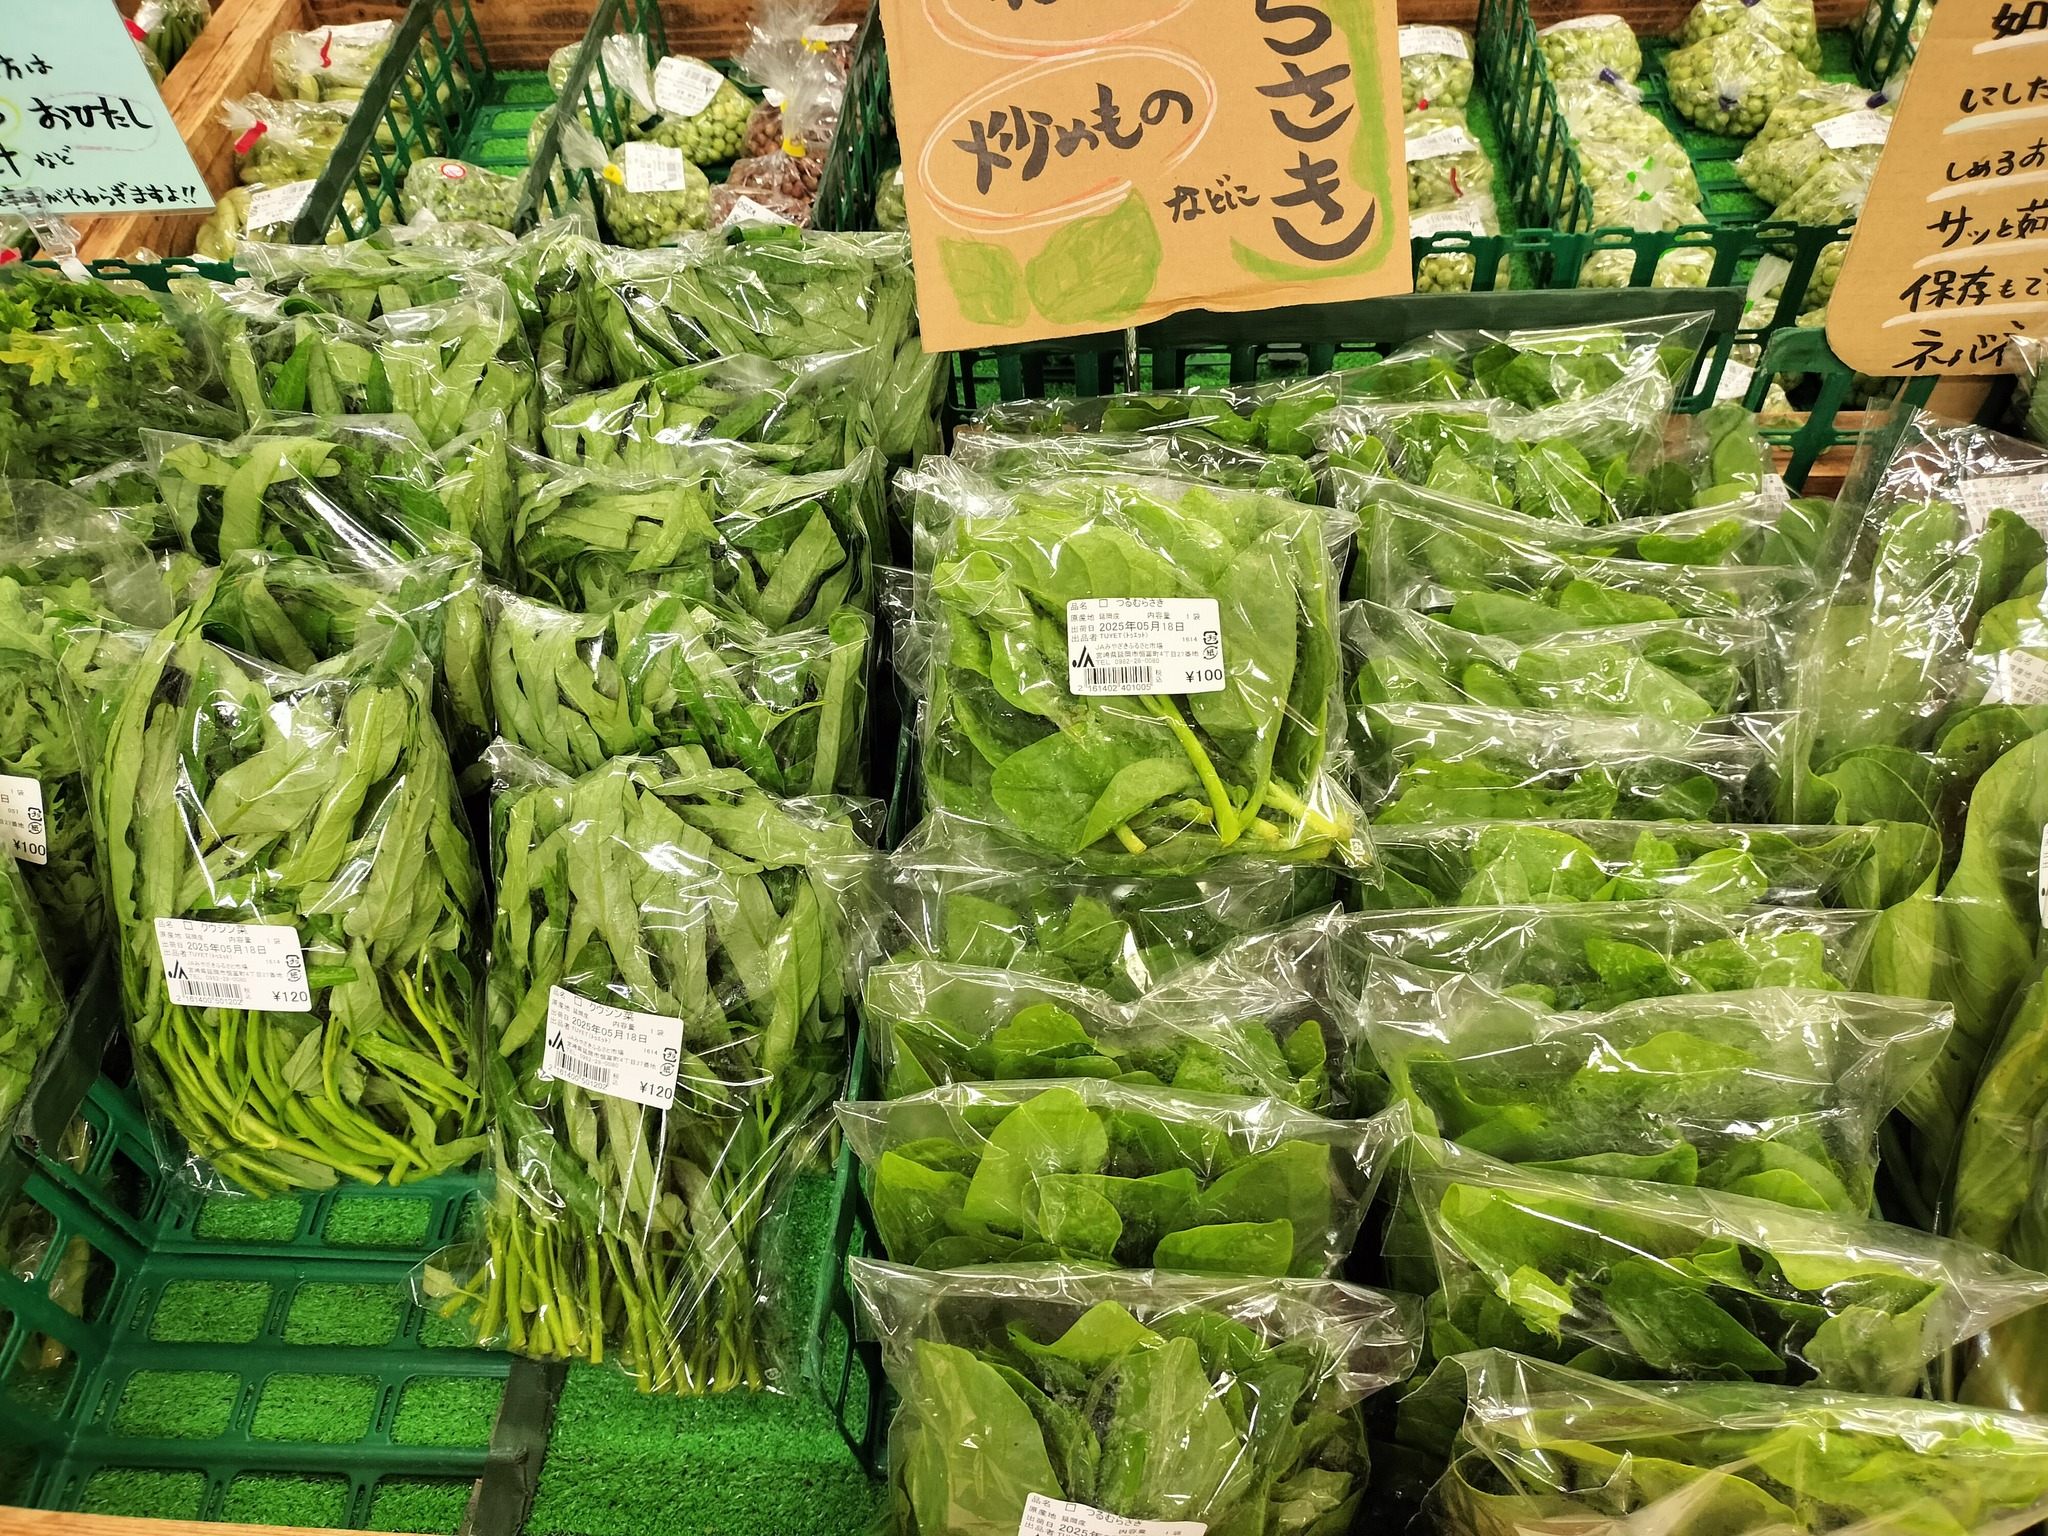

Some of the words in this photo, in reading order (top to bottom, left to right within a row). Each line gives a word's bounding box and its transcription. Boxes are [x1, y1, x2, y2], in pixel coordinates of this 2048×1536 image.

[27, 96, 153, 130] おひたし
[952, 82, 1194, 195] 炒めもの
[34, 145, 74, 169] など
[1164, 174, 1260, 223] などに
[1071, 602, 1087, 610] 品名
[1116, 598, 1164, 608] つるむらさき
[1071, 614, 1095, 622] 原産地
[1147, 612, 1170, 620] 内容量
[1099, 621, 1184, 632] 2025年05月18日
[1071, 633, 1098, 642] 出品者
[1185, 669, 1223, 683] ¥100
[13, 839, 46, 856] ¥100
[201, 924, 248, 934] クウシン菜
[187, 942, 267, 954] 2025年05月18日
[273, 991, 308, 1002] ¥120
[589, 1002, 634, 1021] クウシン菜
[572, 1016, 648, 1043] 2025年05月18日
[640, 1081, 673, 1100] ¥120
[1031, 1496, 1051, 1508] 品名
[1086, 1508, 1142, 1526] つるむらさき
